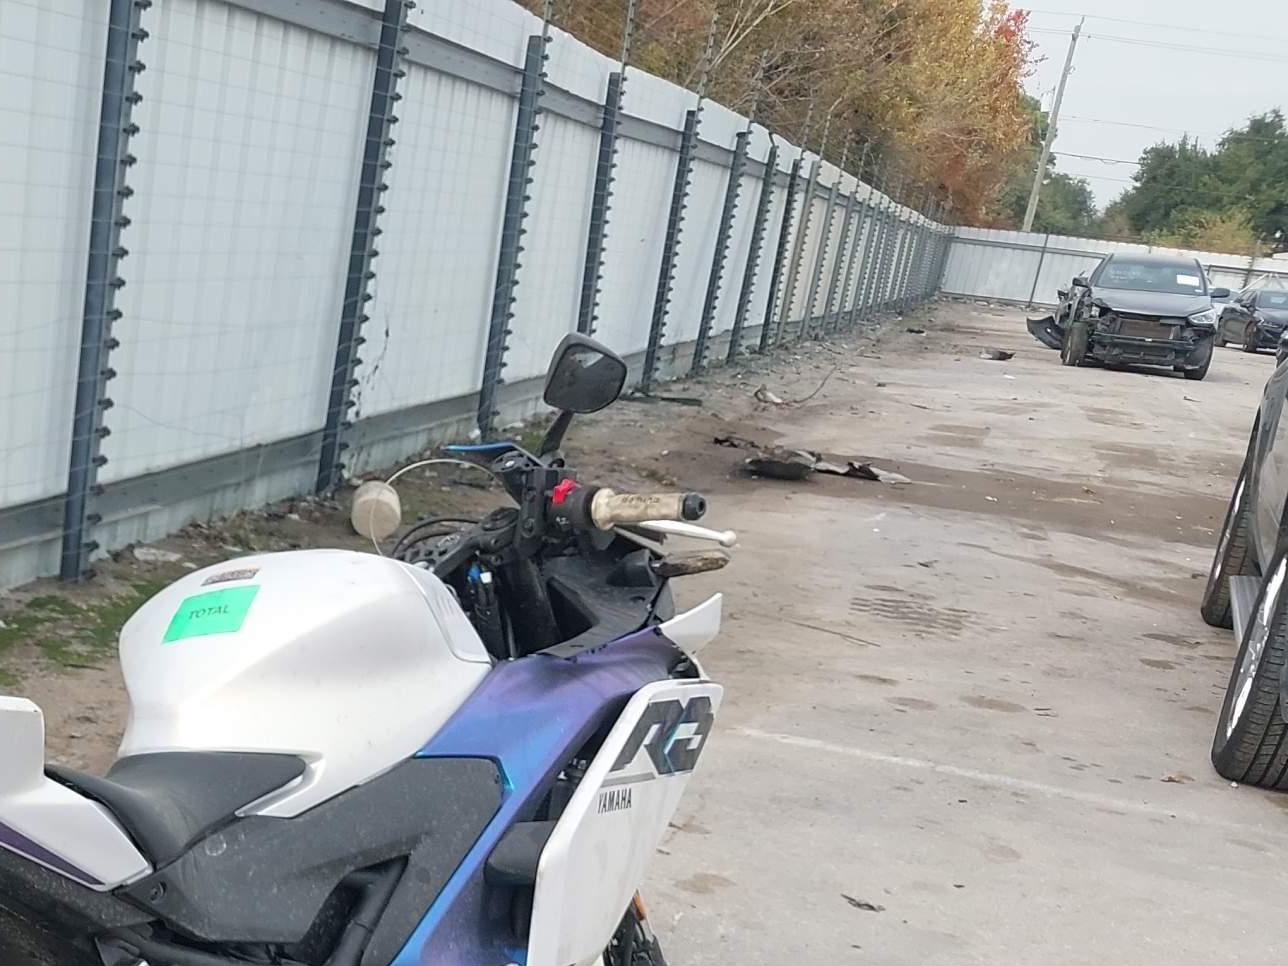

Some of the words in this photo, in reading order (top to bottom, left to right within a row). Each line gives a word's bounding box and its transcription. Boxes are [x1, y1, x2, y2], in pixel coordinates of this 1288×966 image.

[188, 604, 231, 620] TOTAL
[609, 696, 714, 775] R3
[597, 787, 632, 815] YAMAHA
